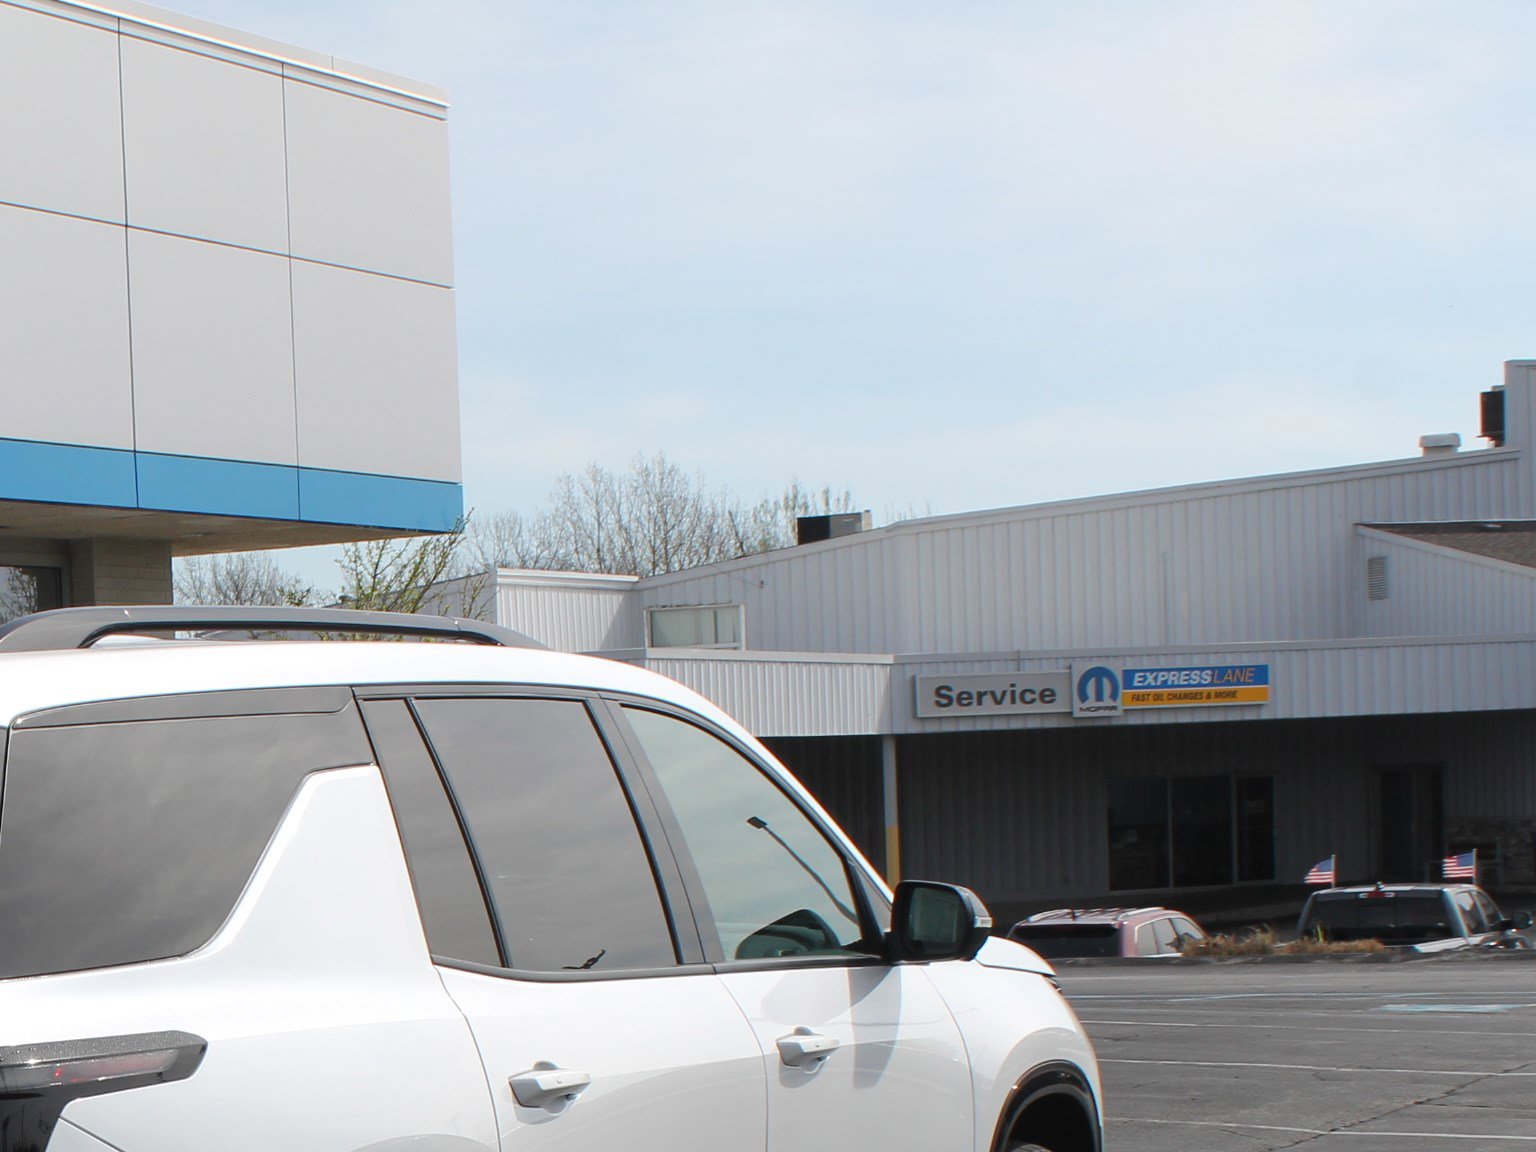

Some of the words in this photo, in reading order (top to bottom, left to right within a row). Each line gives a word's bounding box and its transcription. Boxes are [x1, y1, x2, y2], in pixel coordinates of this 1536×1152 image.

[933, 683, 1057, 708] Service
[1131, 693, 1151, 702] FAST
[1152, 692, 1164, 702] OIL
[1167, 691, 1204, 701] CHANGES
[1214, 690, 1238, 700] MORE
